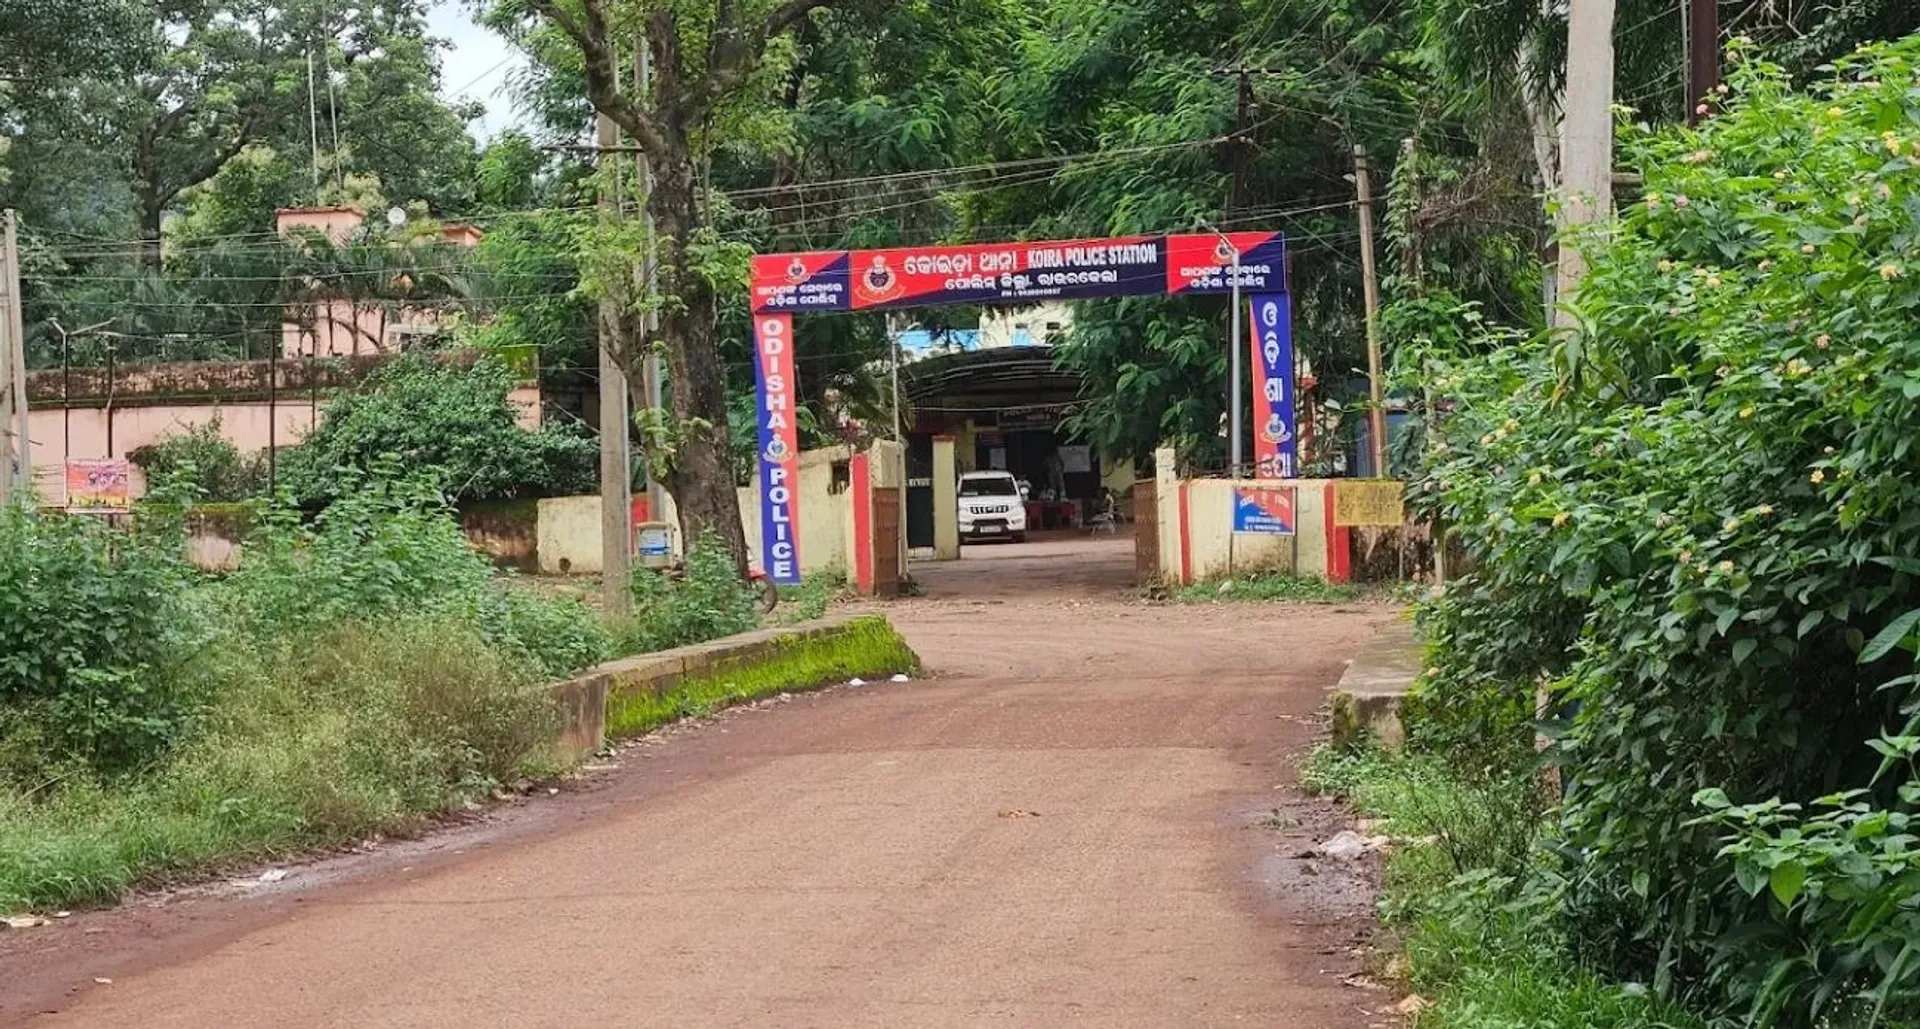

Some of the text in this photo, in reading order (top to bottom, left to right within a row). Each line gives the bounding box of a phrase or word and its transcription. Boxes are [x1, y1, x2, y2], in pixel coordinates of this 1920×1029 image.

[979, 250, 1017, 272] ଥାନା
[1027, 248, 1064, 269] KOIRA
[1065, 246, 1107, 266] POLICE
[1108, 243, 1157, 264] STATION
[1037, 269, 1117, 286] ରାଉରକେଲା
[762, 319, 789, 430] ODISHA
[768, 467, 793, 578] POLICE
